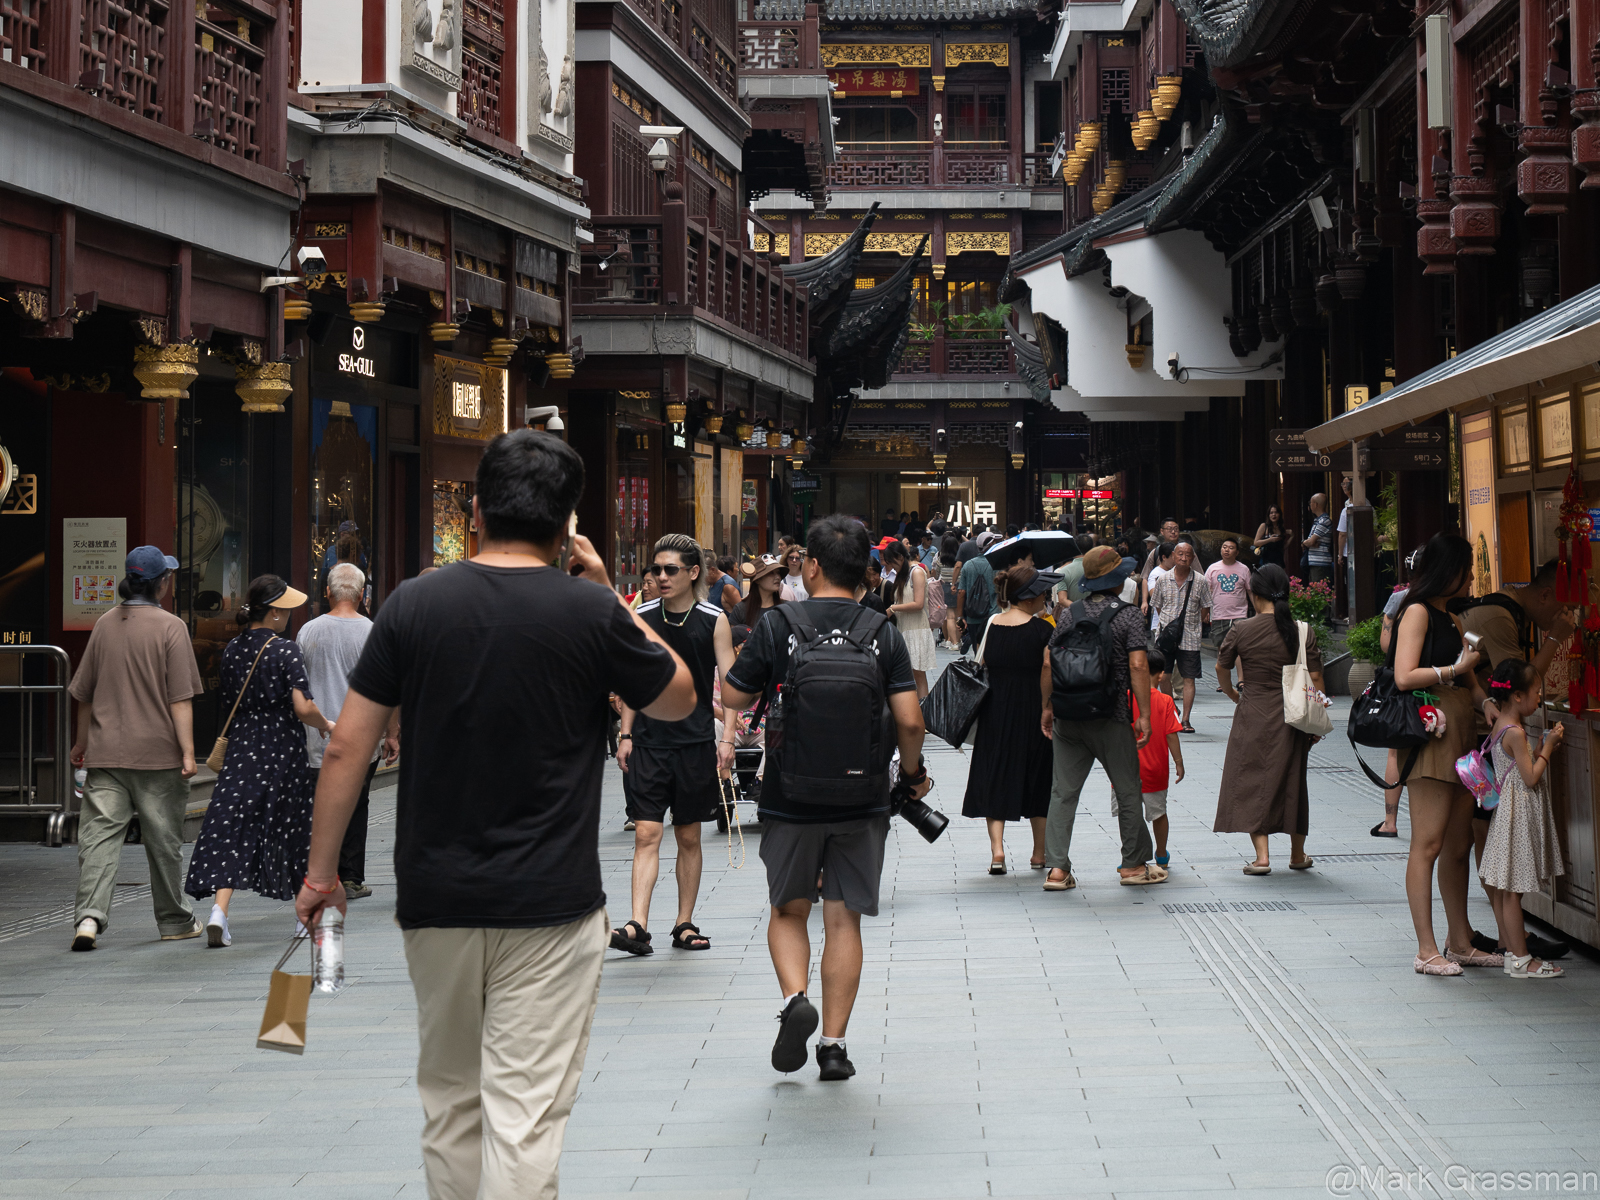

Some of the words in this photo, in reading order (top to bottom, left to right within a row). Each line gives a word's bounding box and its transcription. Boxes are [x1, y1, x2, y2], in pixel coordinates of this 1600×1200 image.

[829, 69, 908, 90] 小吊梨湯
[339, 353, 375, 377] SEA-GULL
[1353, 390, 1363, 405] 5
[73, 540, 117, 548] 灭火器放置点
